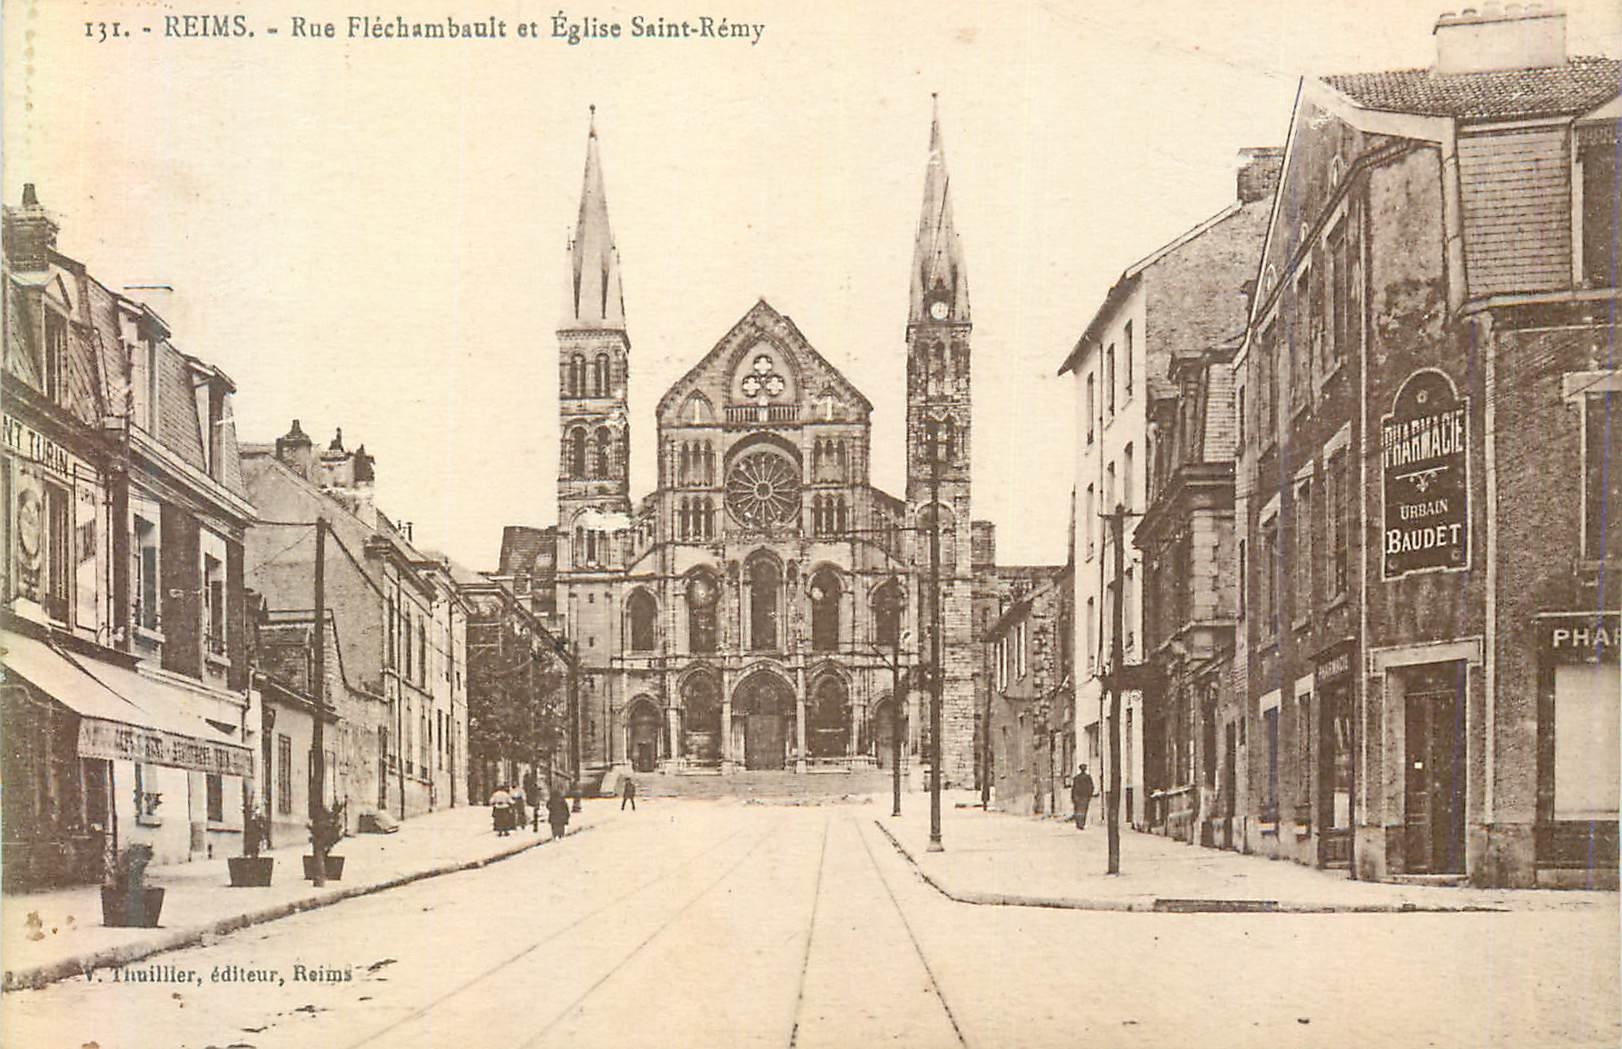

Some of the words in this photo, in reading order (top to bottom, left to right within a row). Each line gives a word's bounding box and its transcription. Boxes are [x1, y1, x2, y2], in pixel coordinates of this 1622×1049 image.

[27, 430, 68, 479] TURIN
[1384, 409, 1465, 469] PHARMACIE
[1400, 498, 1448, 520] URBAIN
[1386, 523, 1462, 555] BAUDET
